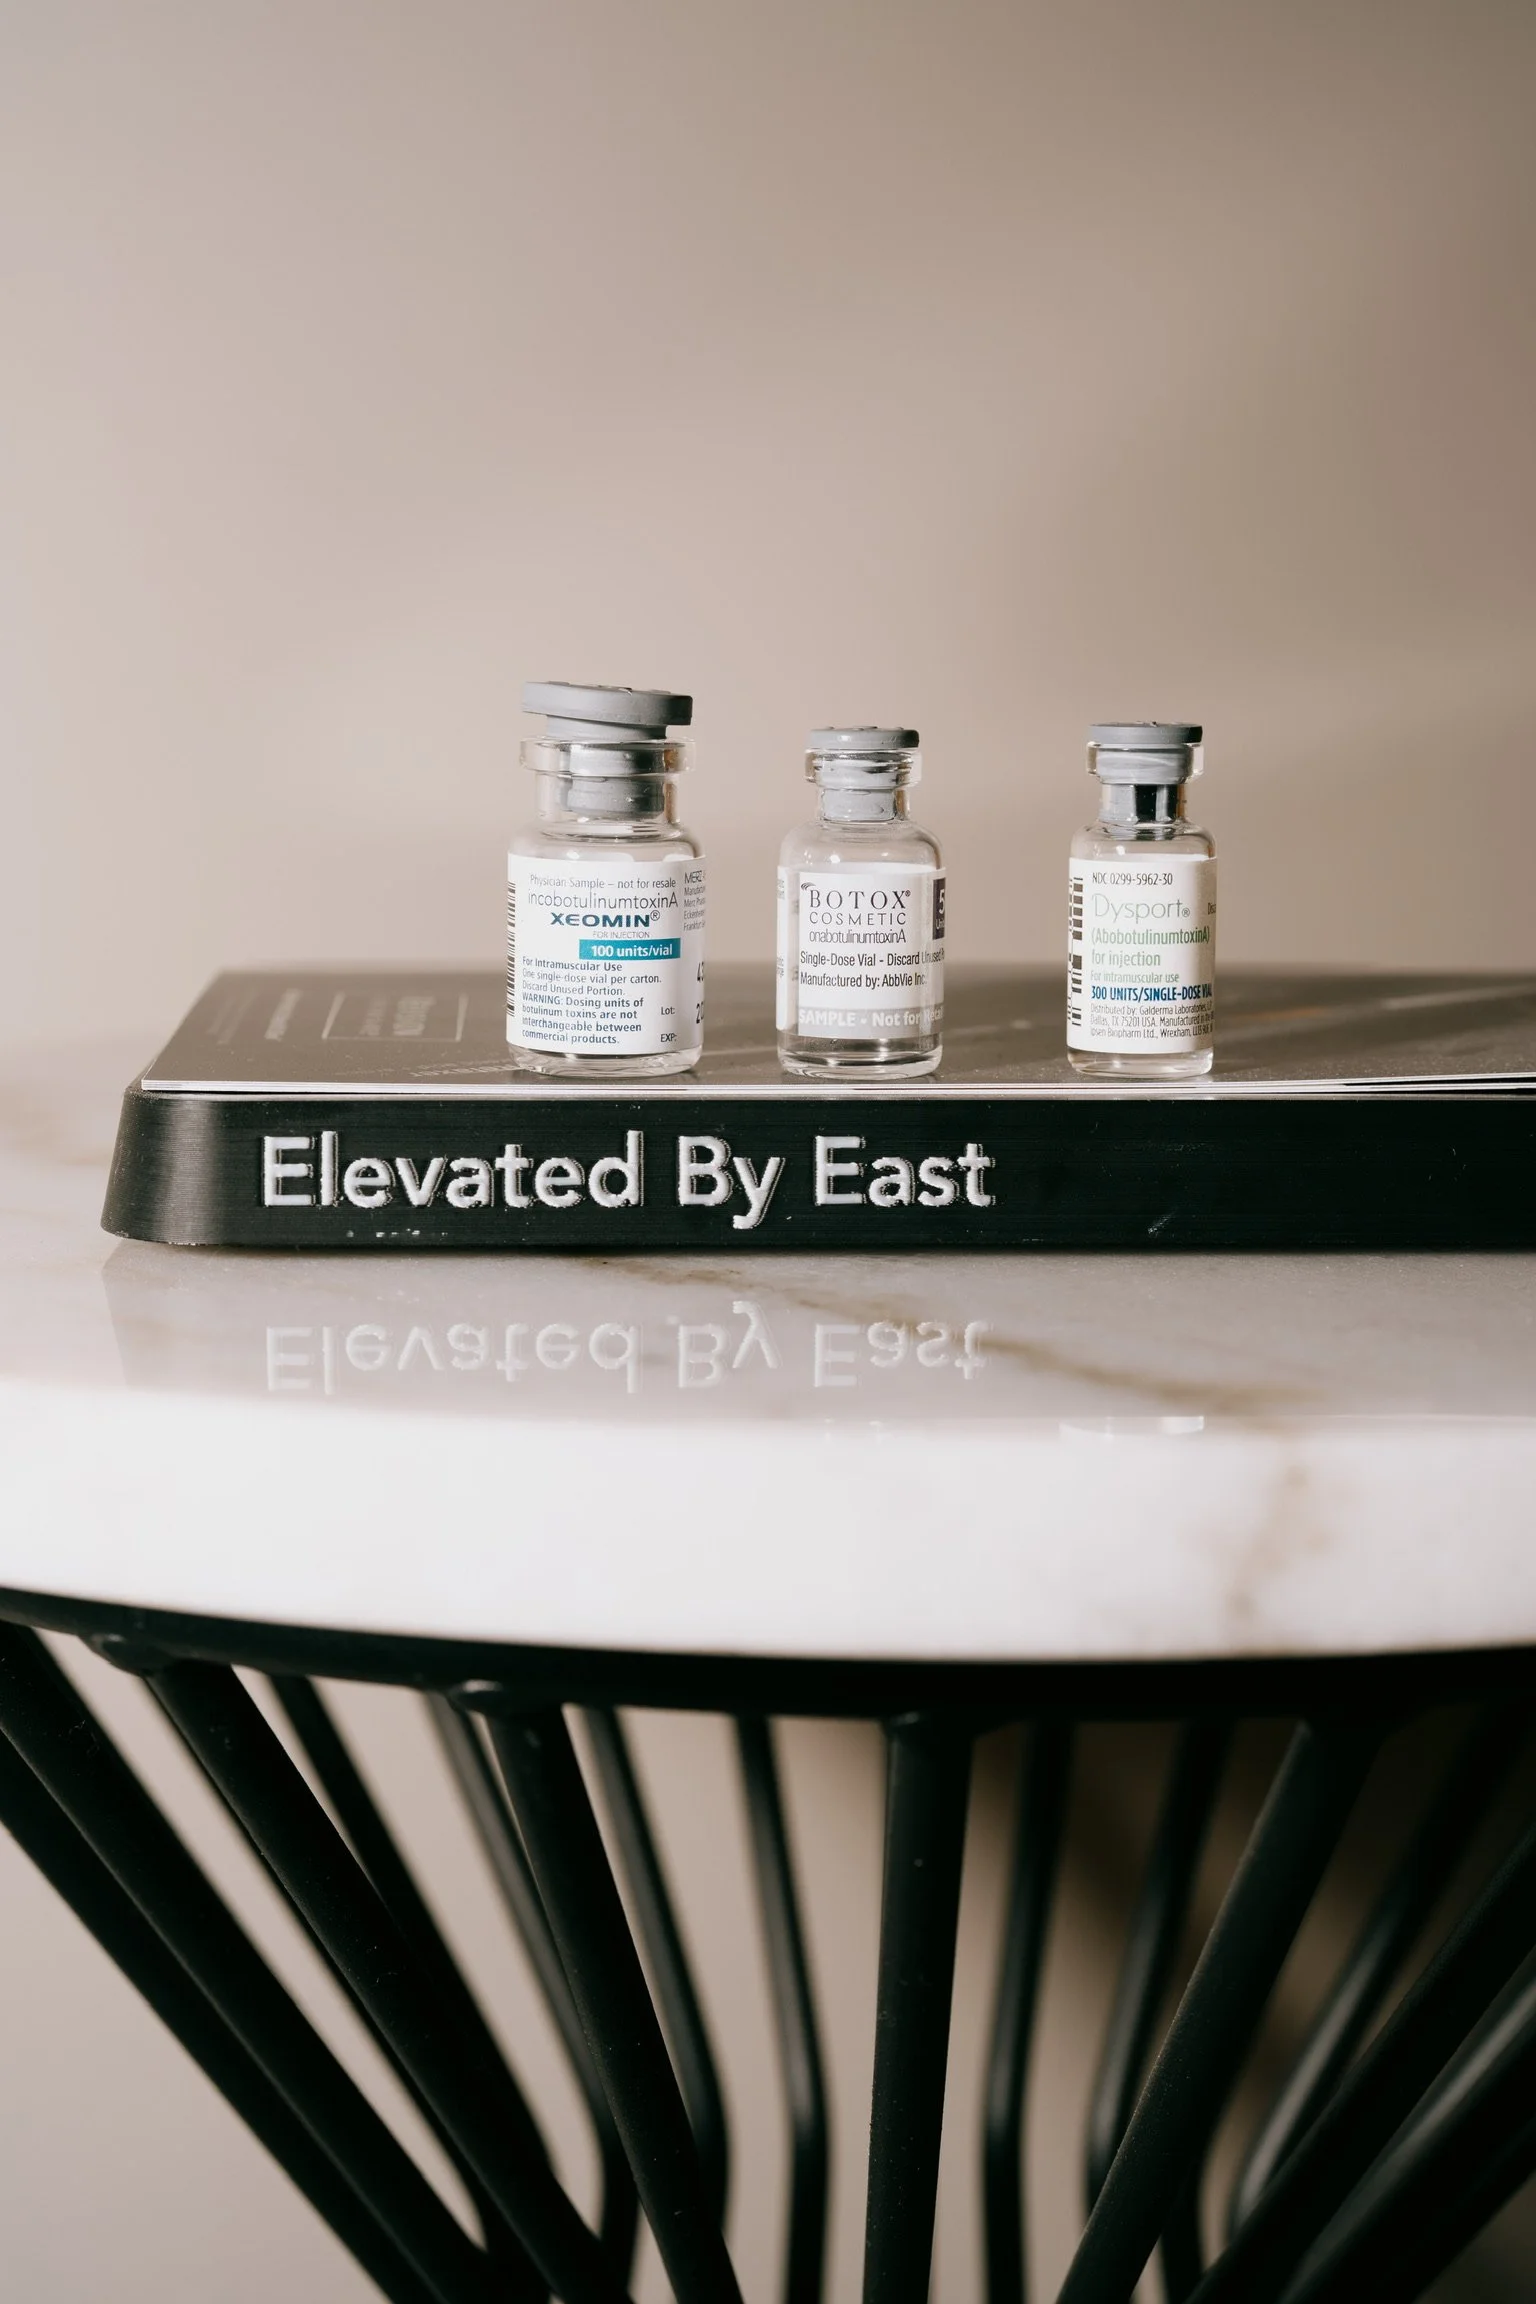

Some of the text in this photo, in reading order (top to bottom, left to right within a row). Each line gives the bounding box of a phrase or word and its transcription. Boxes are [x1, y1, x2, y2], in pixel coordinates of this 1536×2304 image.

[530, 874, 566, 888] Physician
[570, 878, 604, 889] Sample
[618, 879, 633, 889] not
[637, 878, 649, 889] for
[652, 878, 676, 889] resale
[1093, 872, 1173, 885] NDC 0299-5962-30
[528, 888, 678, 909] incobotulinumtoxinA
[809, 911, 906, 925] COSMETIC
[611, 931, 650, 939] INJECTION
[809, 929, 906, 944] onabotulinumtoxinA
[1092, 926, 1210, 945] (AbobotulinumtoxinA)
[592, 944, 672, 957] 100 units/vial
[523, 956, 623, 972] For Intramuscular Use
[800, 951, 855, 968] Single-Dose
[858, 952, 876, 967] Vial
[887, 953, 920, 966] Discard
[1092, 949, 1161, 968] for injection
[523, 969, 661, 985] One single-dose vial per carton.
[800, 971, 862, 987] Manufactured
[866, 977, 880, 990] by:
[882, 974, 913, 987] AbbVie
[915, 972, 927, 986] Inc.
[1091, 970, 1179, 983] For intramuscular use
[523, 981, 625, 996] Discard Unused Portion.
[1092, 986, 1106, 999] 300
[1110, 985, 1200, 1003] UNITS/SINGLE-DOSE
[523, 992, 643, 1009] WARNING: Dosing units of
[523, 1004, 562, 1016] botulinum
[566, 1008, 596, 1019] toxins
[620, 1010, 637, 1019] not
[661, 1006, 675, 1015] Lot:
[1091, 1003, 1125, 1015] Distributed
[1140, 1005, 1173, 1015] Galderma
[523, 1016, 641, 1034] interchangeable between
[799, 1009, 855, 1026] SAMPLE
[873, 1013, 900, 1027] Not
[904, 1011, 920, 1026] for
[1091, 1013, 1109, 1026] Dallas,
[1112, 1015, 1119, 1026] TX
[1121, 1016, 1139, 1027] 75201
[1160, 1013, 1200, 1027] Manufactured
[523, 1029, 619, 1045] commercial products.
[661, 1033, 677, 1043] EXP:
[1108, 1028, 1141, 1039] Biopharm
[1160, 1027, 1191, 1038] Wrexham,
[263, 1130, 995, 1230] Elevated By East
